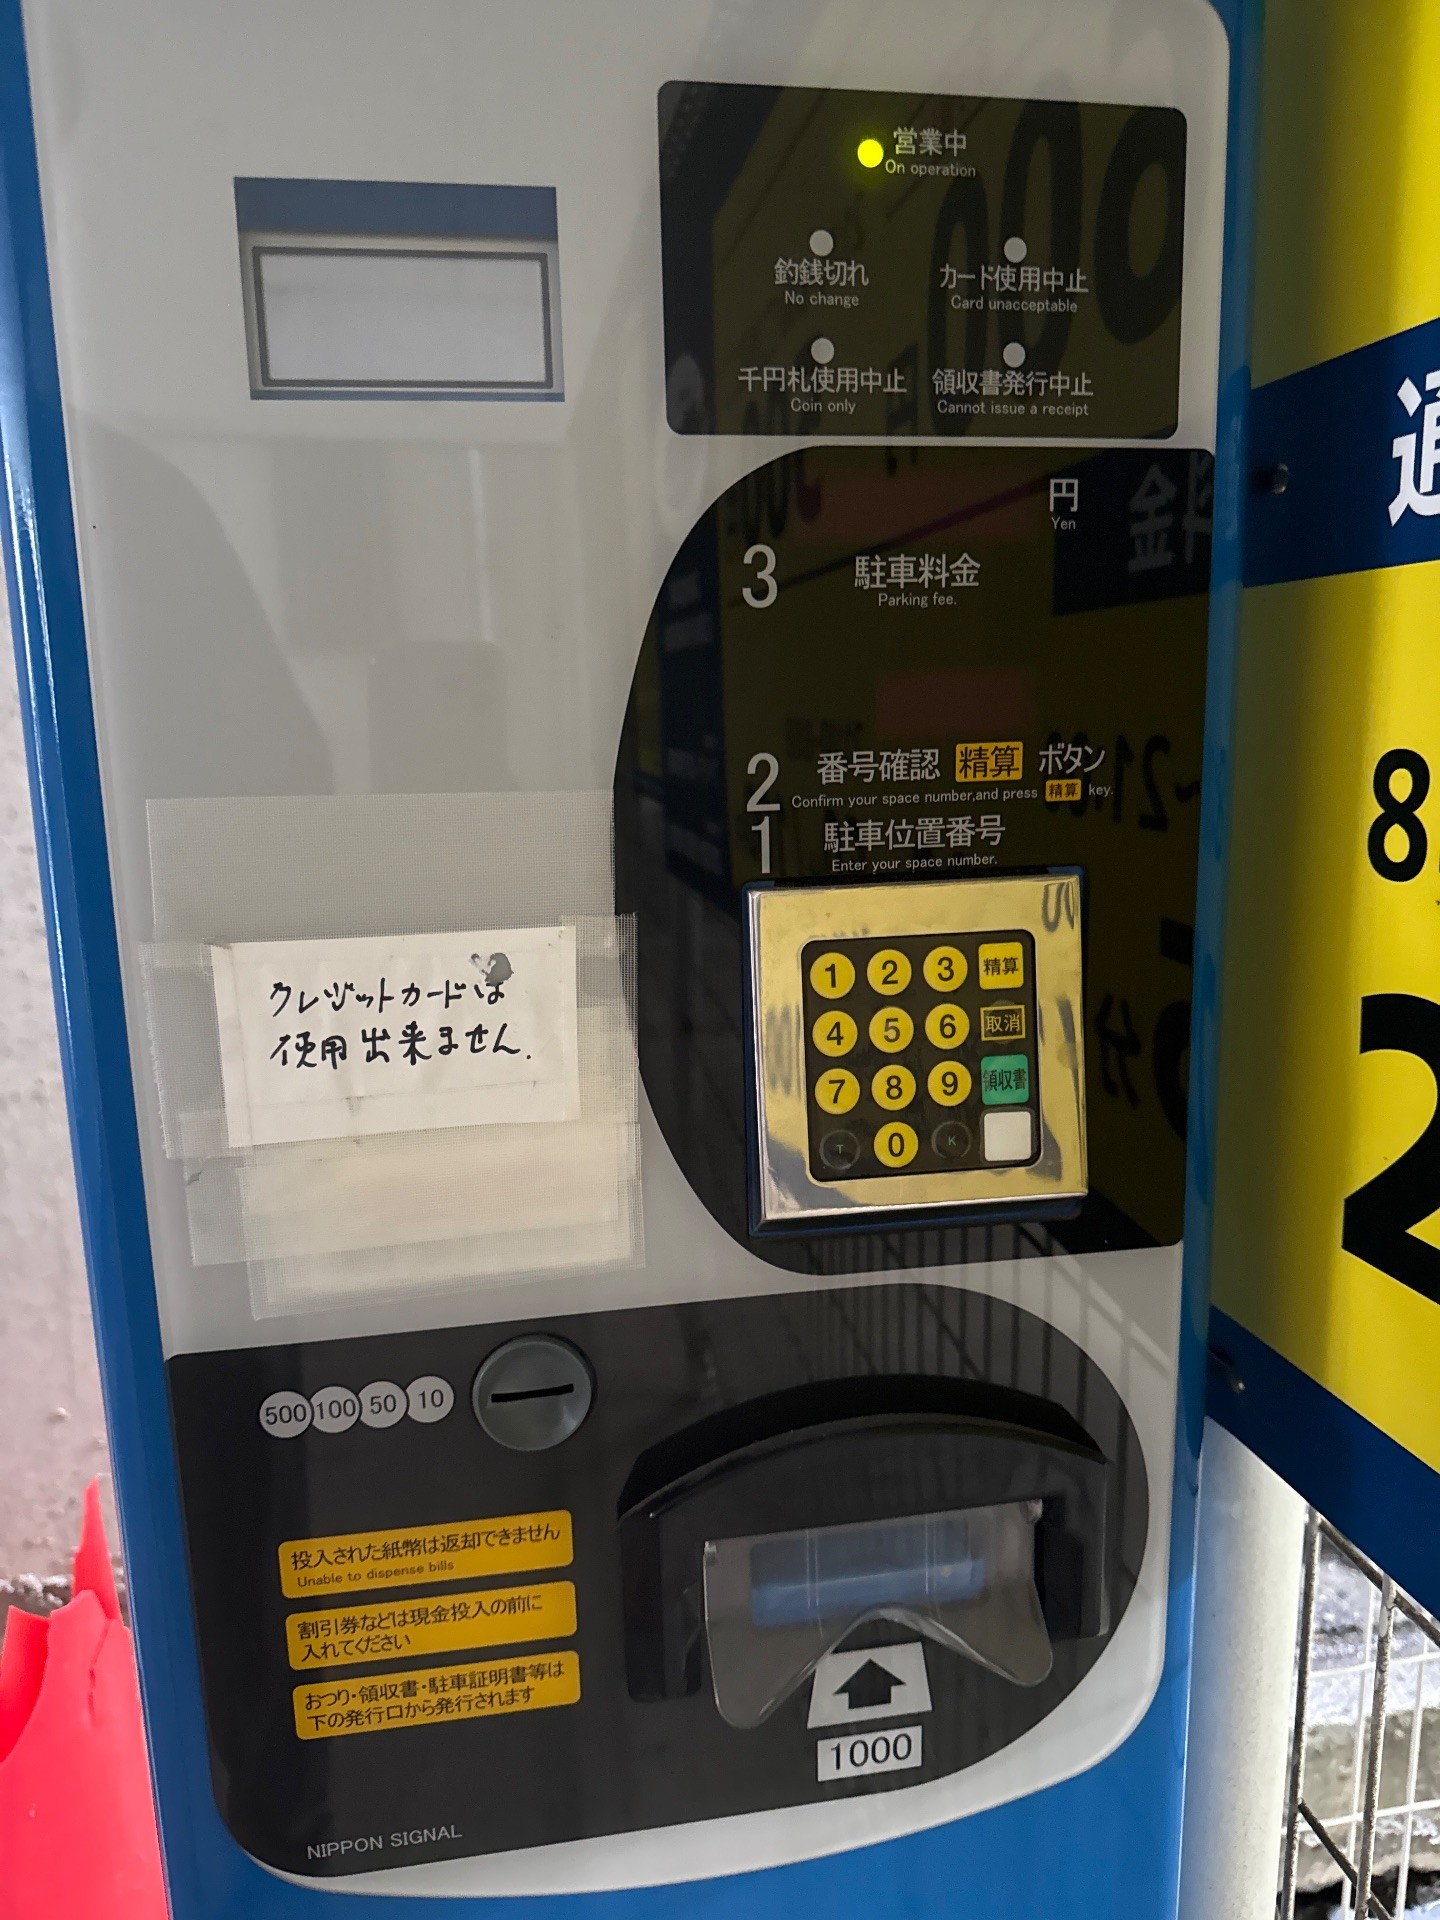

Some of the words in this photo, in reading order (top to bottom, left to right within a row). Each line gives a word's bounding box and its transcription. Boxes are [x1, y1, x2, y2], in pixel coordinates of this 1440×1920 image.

[892, 127, 967, 157] 営業中
[885, 160, 905, 175] On
[910, 163, 976, 178] operation
[774, 257, 870, 288] 釣銭切れ
[940, 264, 1089, 295] カード使用中止
[784, 290, 805, 305] No
[815, 291, 859, 309] change
[950, 294, 984, 310] Card
[988, 298, 1078, 314] unacceptable
[737, 366, 908, 395] 千円札使用中止
[932, 367, 1094, 398] 領収書発行中止
[790, 396, 823, 412] Coin
[827, 398, 856, 415] only
[937, 399, 986, 414] Cannot
[990, 404, 1026, 415] issue
[1029, 404, 1038, 415] a
[1042, 403, 1089, 418] receipt
[1049, 478, 1079, 513] 円
[1051, 516, 1076, 530] Yen
[742, 544, 778, 609] 3
[854, 552, 981, 589] 駐車料金
[878, 592, 929, 608] Parking
[932, 591, 957, 606] fee.
[816, 748, 941, 785] 番号確認
[958, 745, 1021, 779] 精算
[1038, 742, 1106, 775] ボタン
[746, 752, 781, 812] 2
[791, 794, 844, 808] Confirm
[848, 795, 878, 808] your
[882, 794, 920, 807] space
[1002, 789, 1038, 802] press
[1049, 782, 1079, 798] 精算
[1088, 783, 1114, 798] key.
[751, 815, 771, 874] 1
[823, 814, 1006, 853] 駐車位置番号
[831, 859, 868, 872] Enter
[871, 860, 901, 872] your
[905, 858, 943, 871] space
[947, 852, 998, 867] number.
[824, 963, 837, 989] 1
[881, 959, 899, 985] 2
[937, 956, 955, 982] 3
[983, 956, 1019, 976] 精算
[826, 1021, 845, 1046] 4
[883, 1017, 901, 1043] 5
[939, 1013, 957, 1039] 6
[985, 1013, 1021, 1033] 取消
[828, 1078, 846, 1104] 7
[885, 1074, 903, 1101] 8
[941, 1071, 959, 1097] 9
[982, 1068, 1027, 1092] 領収書
[888, 1132, 905, 1158] 0
[948, 1135, 957, 1146] K
[265, 1403, 307, 1425] 500
[316, 1398, 356, 1420] 100
[370, 1394, 397, 1415] 50
[419, 1389, 444, 1409] 10
[291, 1523, 561, 1571] 投入された紙幣は返却できません
[297, 1572, 343, 1589] Unable
[347, 1571, 362, 1582] to
[366, 1564, 425, 1580] dispense
[428, 1560, 455, 1573] bills
[297, 1594, 542, 1640] 割引券などは現金投入の前に
[301, 1633, 411, 1662] 入れてください
[307, 1686, 535, 1731] 下の発行口から発行されます
[829, 1732, 912, 1770] 1000
[307, 1835, 383, 1860] NIPPON
[390, 1824, 463, 1847] SIGNAL
